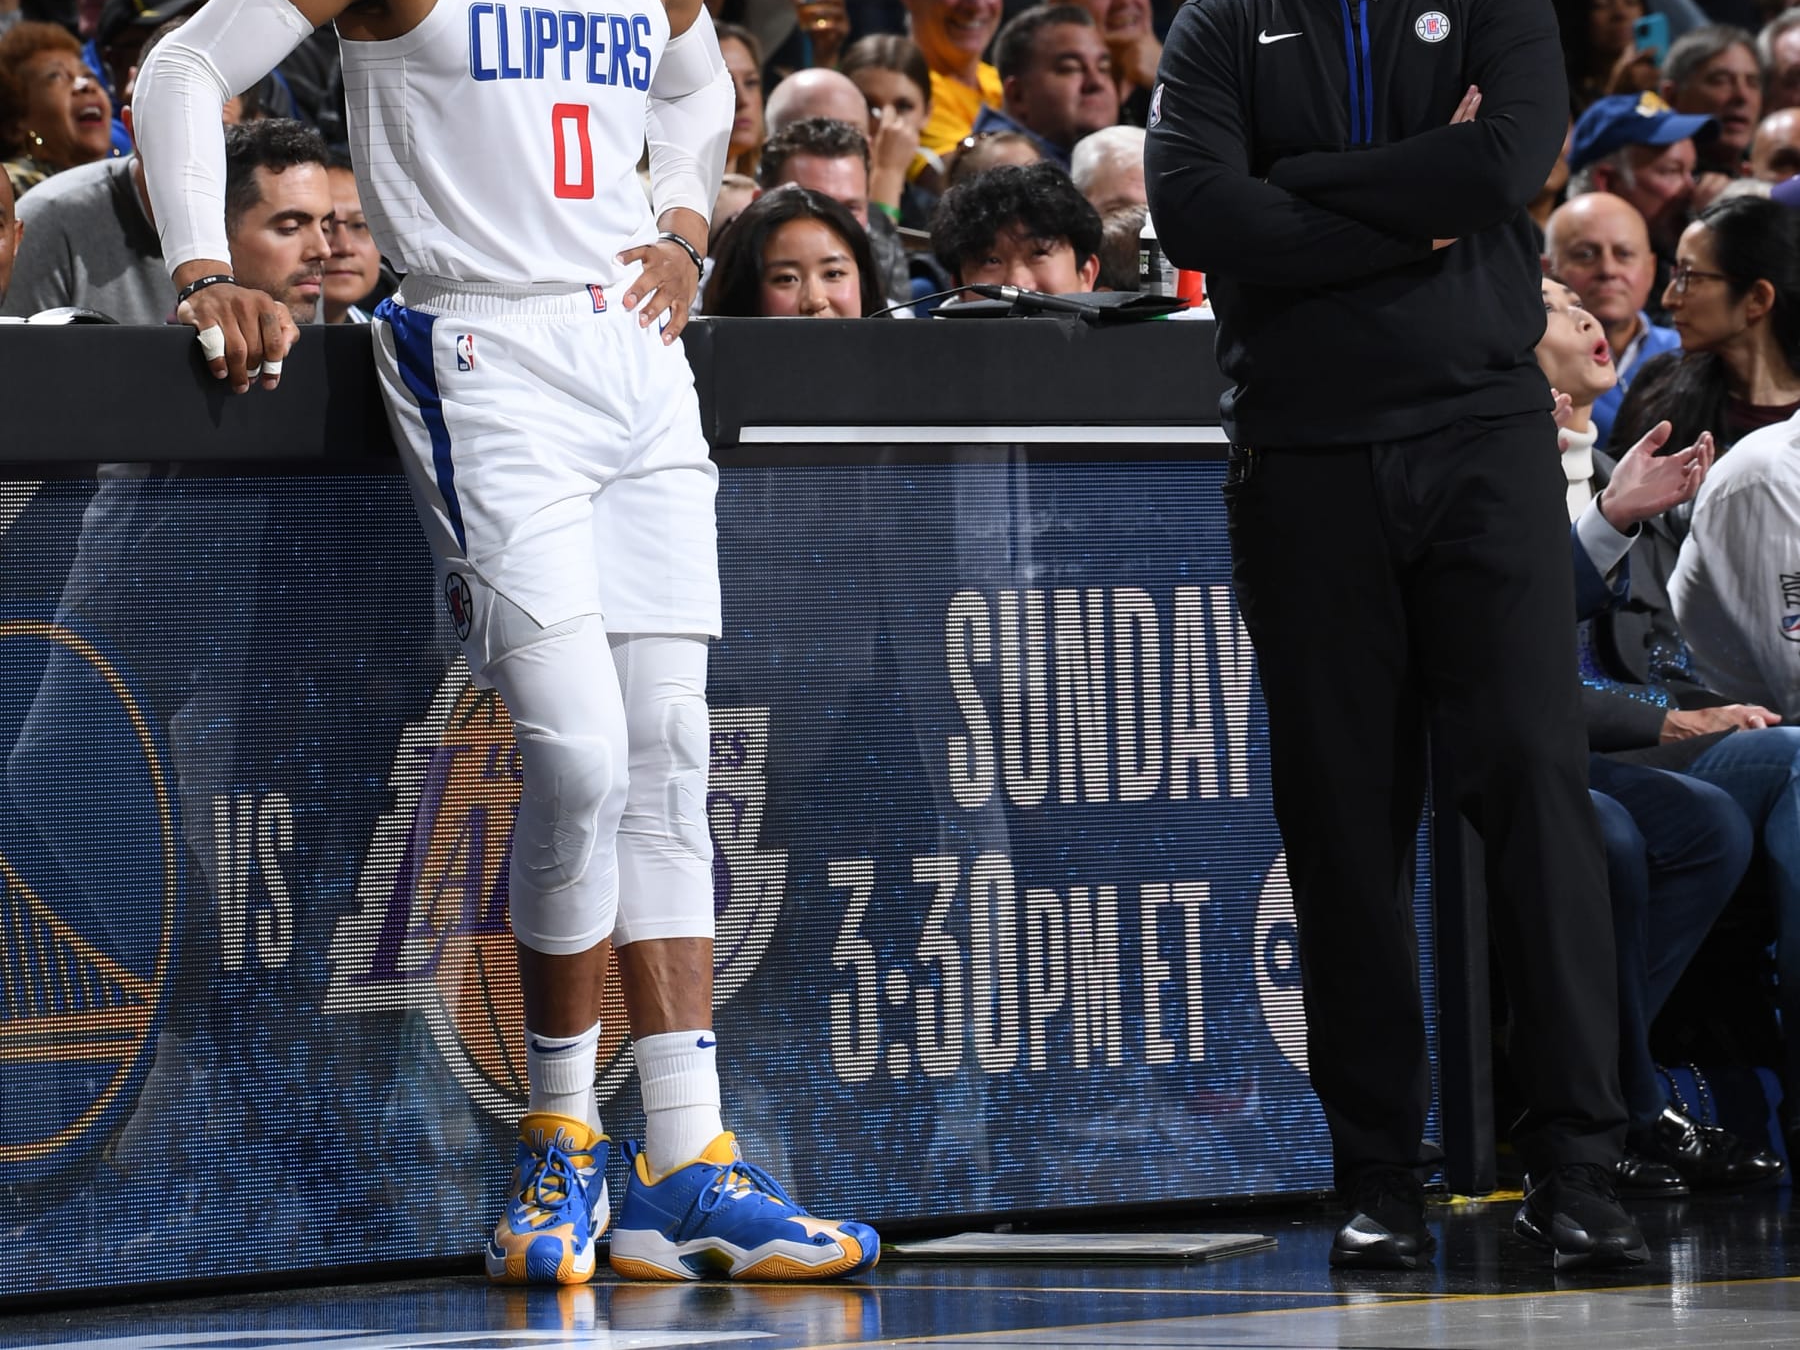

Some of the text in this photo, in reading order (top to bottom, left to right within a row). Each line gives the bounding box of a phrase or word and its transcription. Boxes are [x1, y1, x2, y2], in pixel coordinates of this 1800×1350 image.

[468, 2, 651, 92] CLIPPERS
[552, 103, 594, 199] 0
[946, 585, 1255, 808] SUNDAY
[213, 792, 293, 971] VS
[827, 848, 1210, 1082] 3:30PM ET
